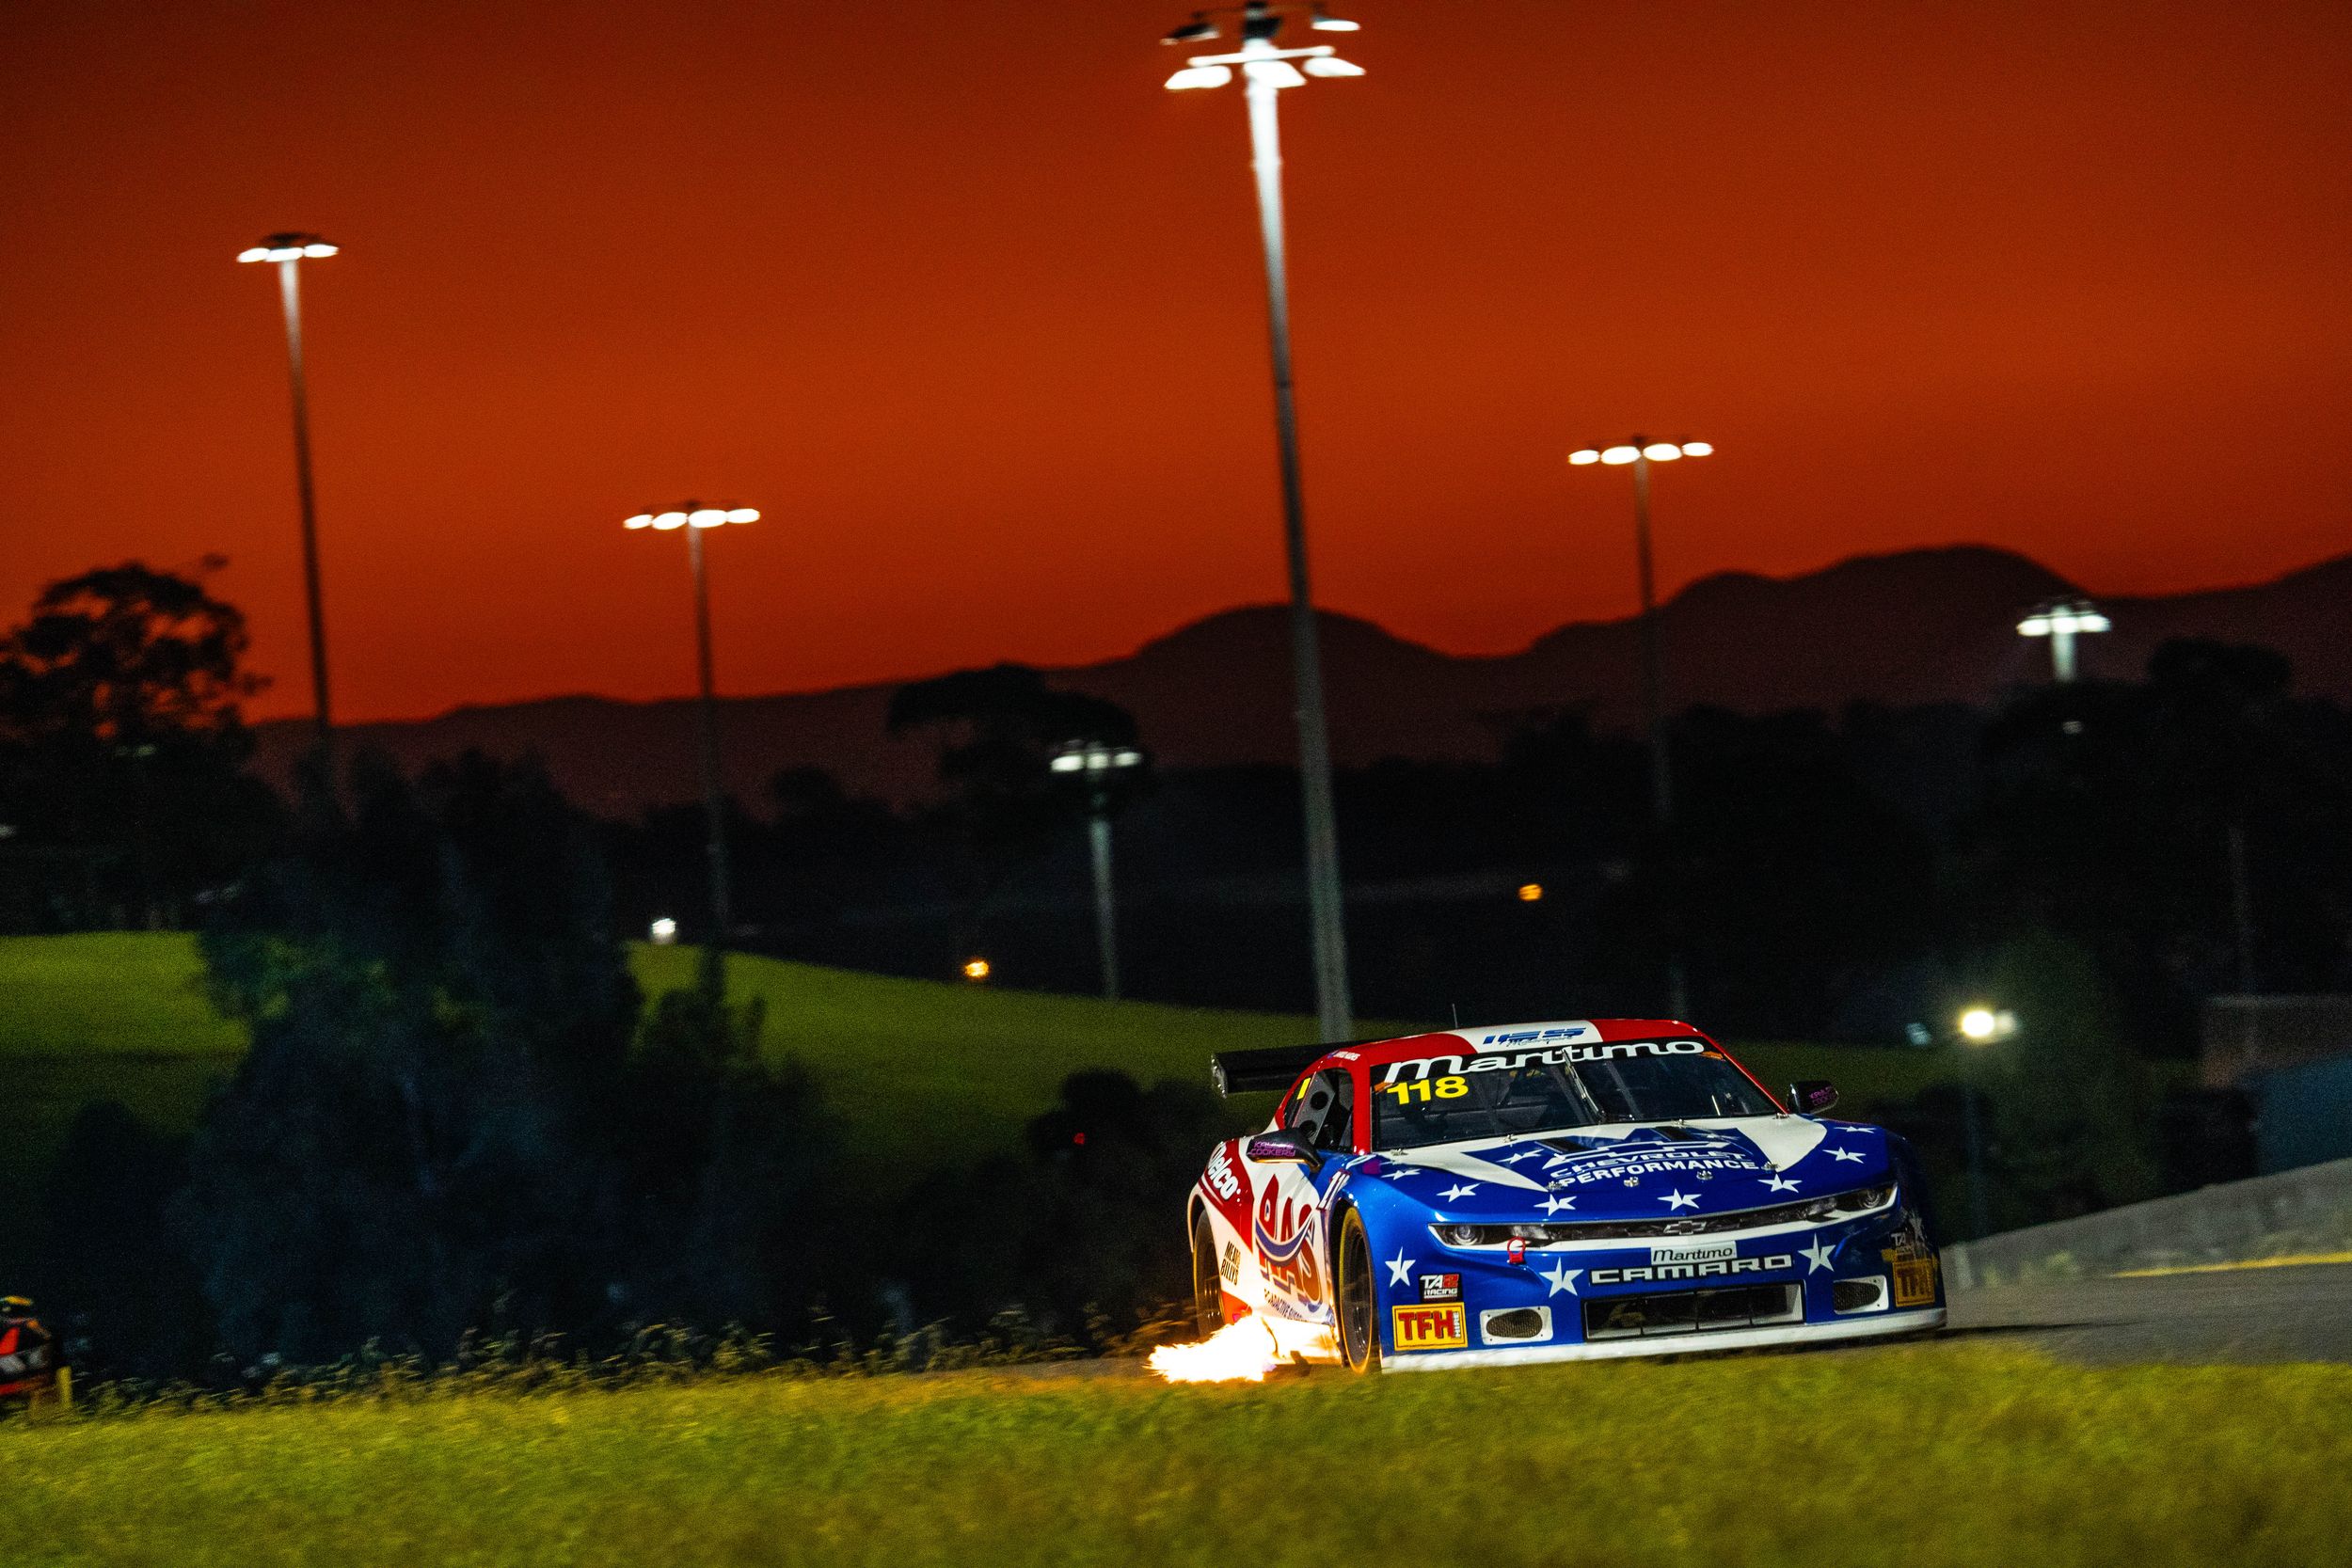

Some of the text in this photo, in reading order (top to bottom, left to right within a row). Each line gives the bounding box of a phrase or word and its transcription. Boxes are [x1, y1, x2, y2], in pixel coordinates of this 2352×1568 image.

[1383, 1041, 1705, 1084] maritimo
[1387, 1076, 1469, 1105] 118
[1550, 1150, 1747, 1178] CHEVROLET
[1558, 1159, 1760, 1187] PERFORMANCE
[1653, 1247, 1733, 1262] Maritimo
[1419, 1273, 1460, 1290] TA2
[1590, 1254, 1792, 1285] CAMARO
[1397, 1308, 1455, 1341] TFH
